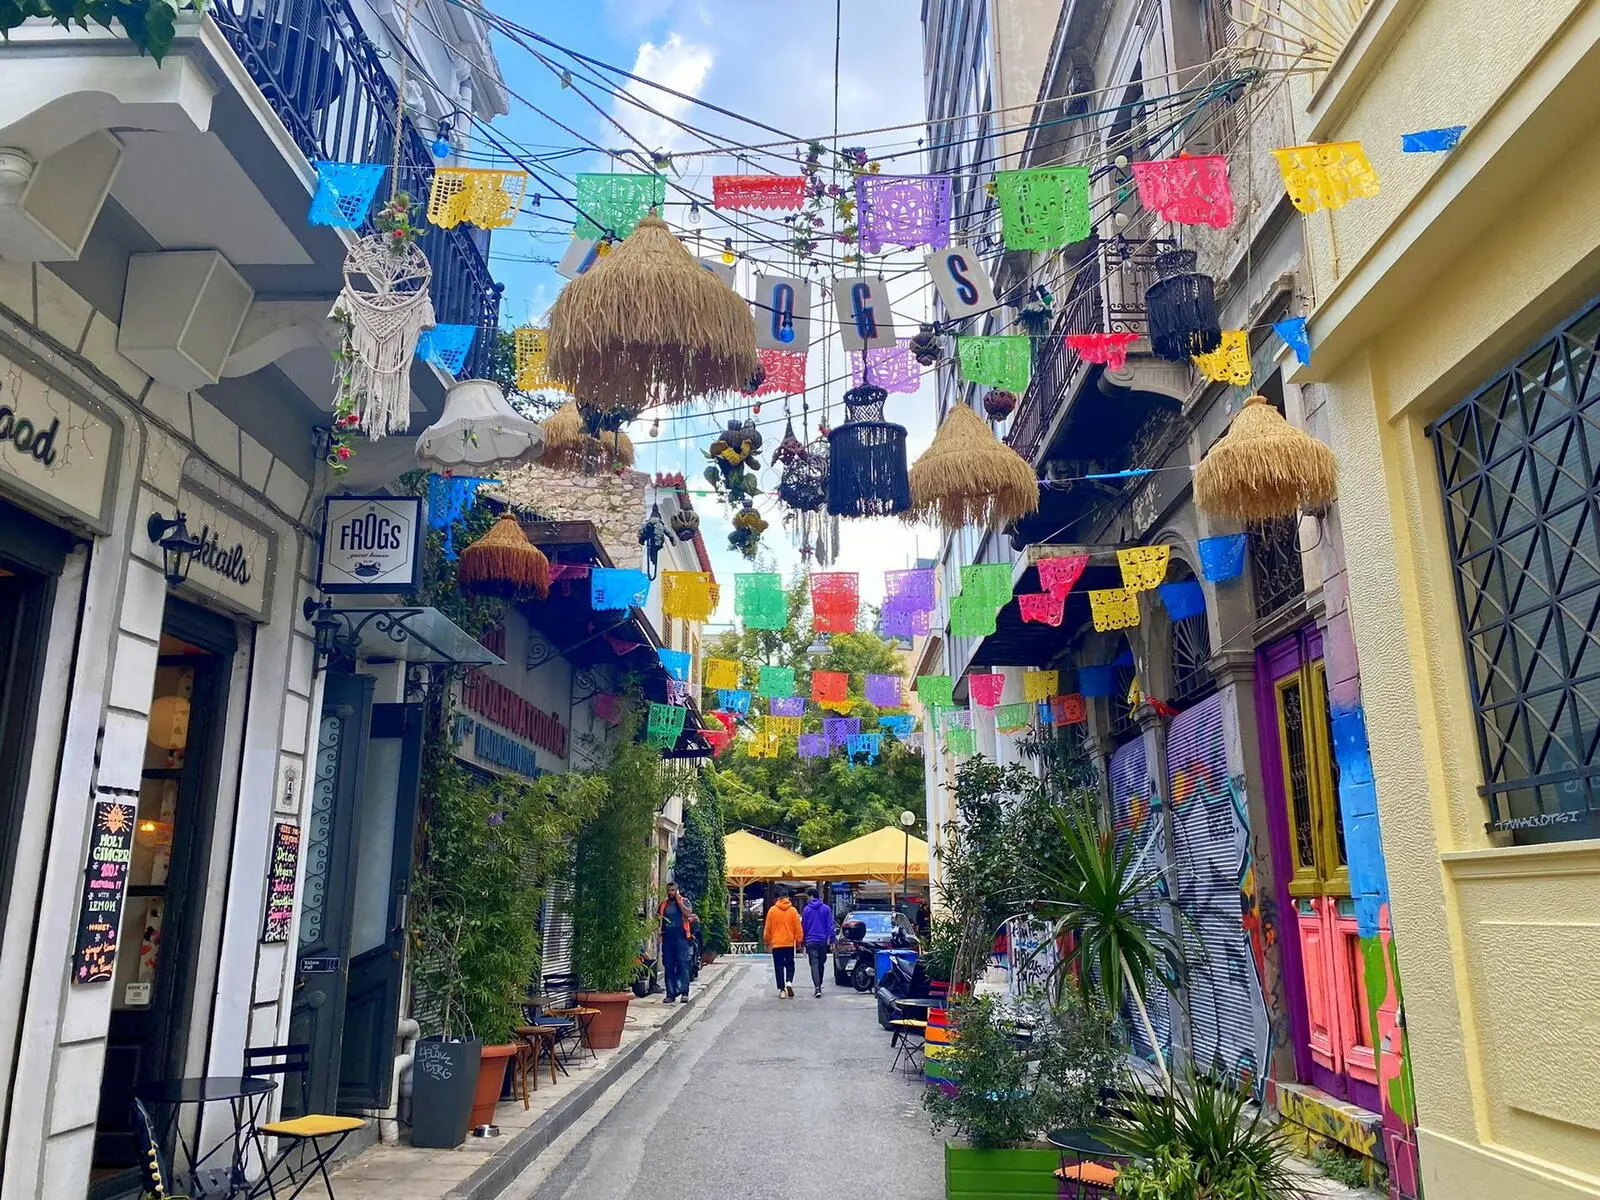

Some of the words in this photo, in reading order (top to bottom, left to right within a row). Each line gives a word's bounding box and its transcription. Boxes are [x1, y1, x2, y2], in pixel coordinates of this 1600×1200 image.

[0, 405, 60, 466] ood
[340, 513, 402, 551] FROGS
[93, 846, 130, 862] GINGER
[276, 847, 295, 863] Detox
[274, 863, 293, 878] Vegan
[273, 879, 294, 892] Juices
[88, 901, 116, 912] LEMON
